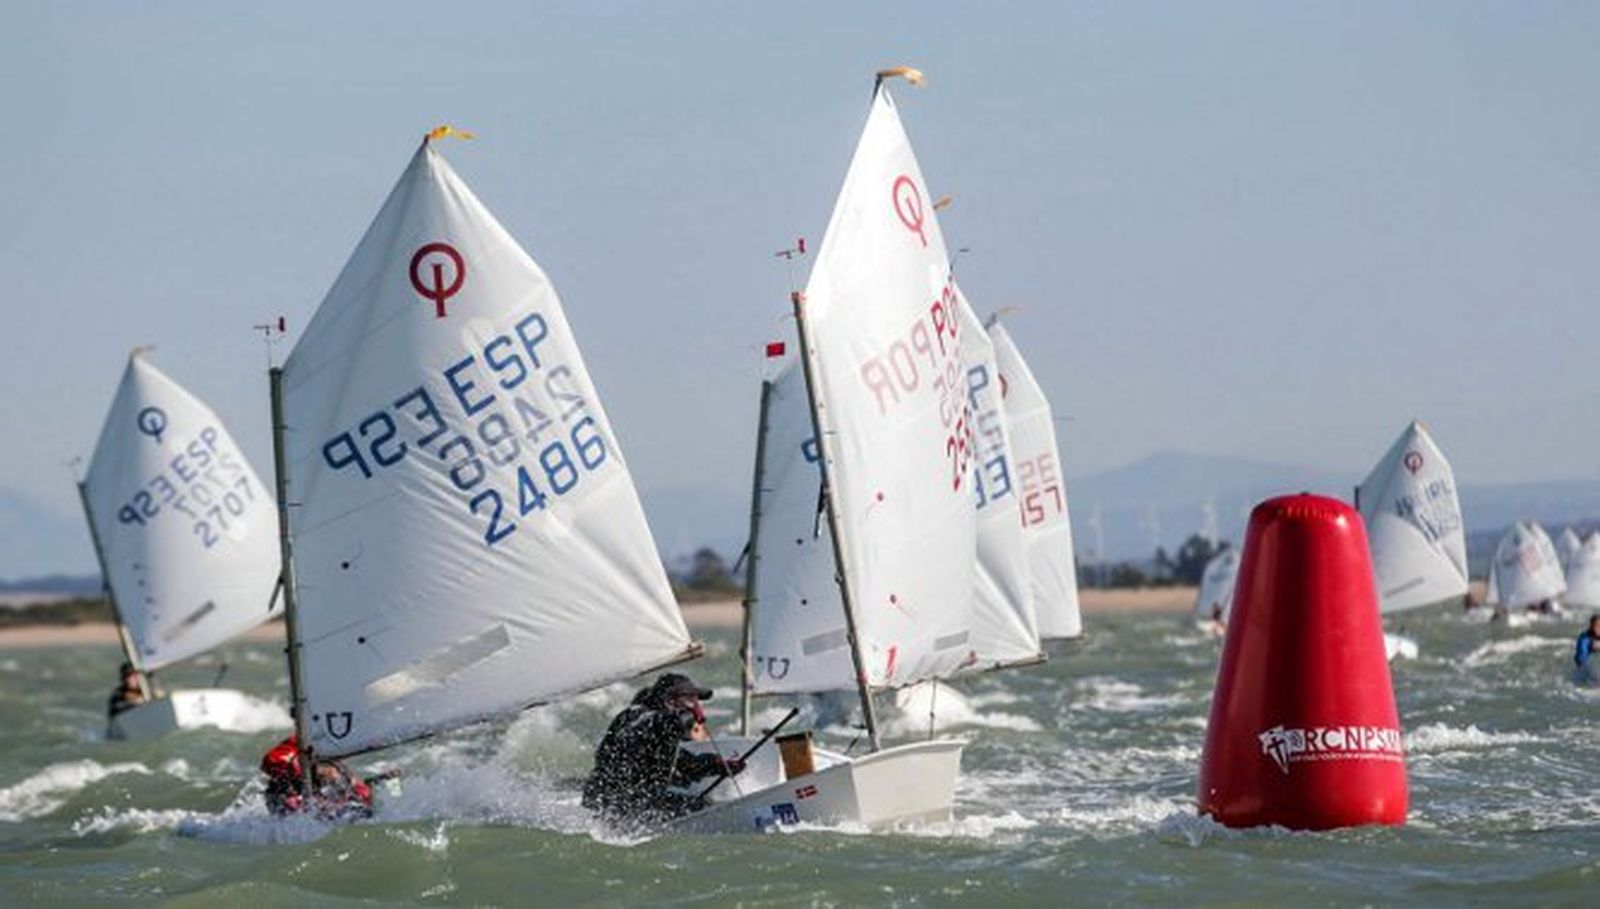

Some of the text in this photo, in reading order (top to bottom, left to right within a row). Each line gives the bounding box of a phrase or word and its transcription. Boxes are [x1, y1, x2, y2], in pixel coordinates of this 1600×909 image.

[443, 312, 549, 418] ESP
[170, 427, 216, 482] ESP
[469, 415, 608, 547] 2486
[193, 476, 254, 548] 2707
